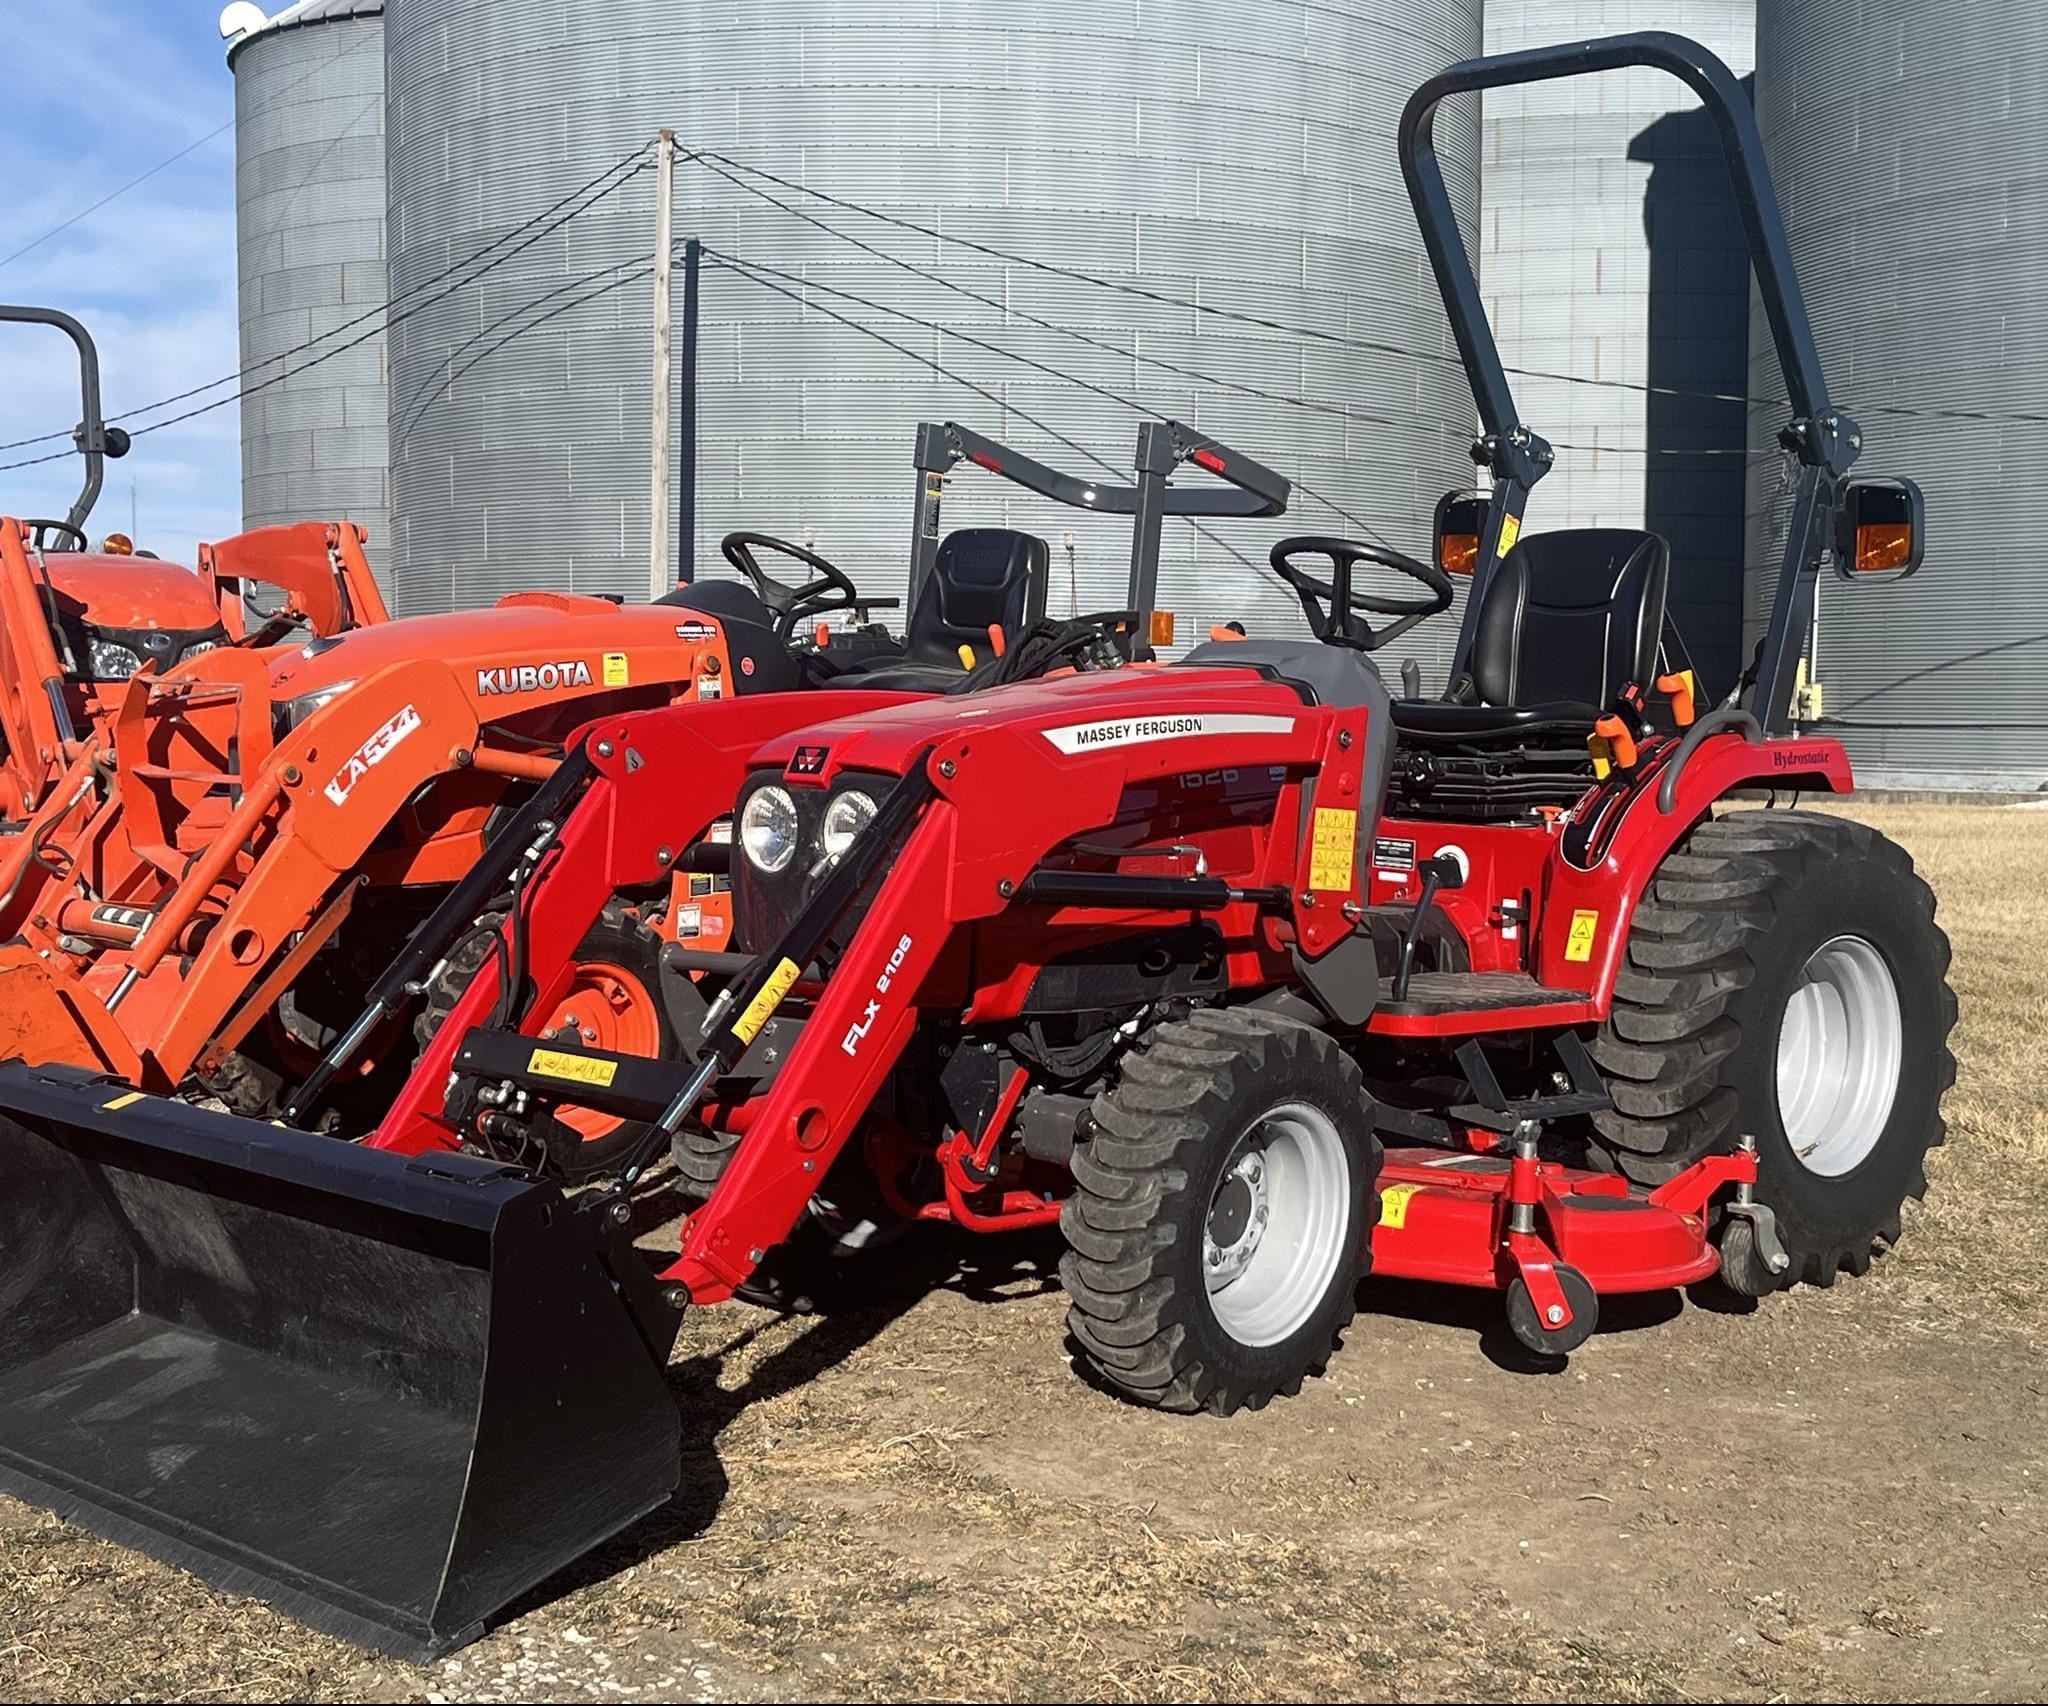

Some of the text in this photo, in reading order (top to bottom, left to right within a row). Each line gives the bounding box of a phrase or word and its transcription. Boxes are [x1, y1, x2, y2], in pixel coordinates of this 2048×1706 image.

[478, 661, 593, 695] KUBOTA
[1077, 718, 1202, 745] MASSEY FERGUSON
[324, 704, 421, 807] LA534
[1773, 751, 1830, 769] Hydrostatic
[840, 933, 913, 1057] FLX 2106
